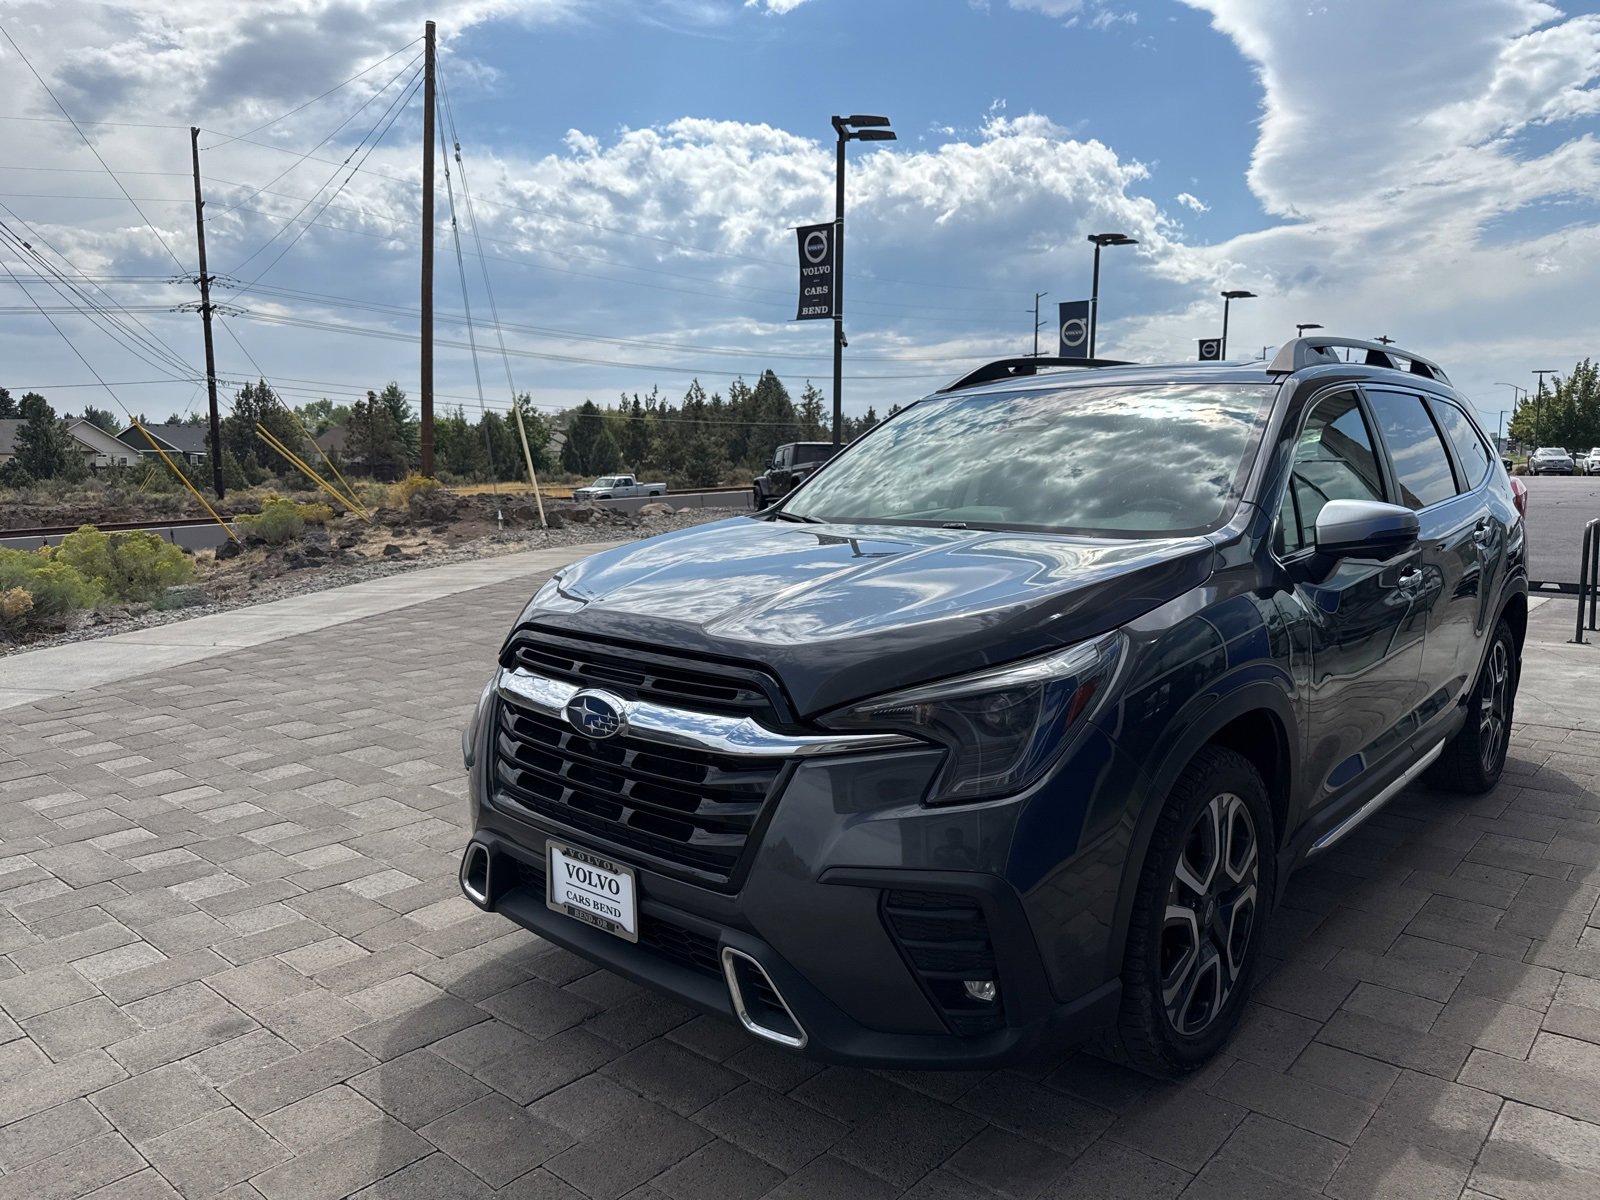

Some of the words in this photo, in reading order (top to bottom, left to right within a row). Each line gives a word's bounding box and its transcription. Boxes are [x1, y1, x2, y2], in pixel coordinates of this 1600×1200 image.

[802, 265, 831, 276] VOLVO
[804, 286, 829, 296] CARS
[801, 305, 829, 315] BEND
[570, 850, 611, 870] VOLVO
[564, 862, 620, 895] VOLVO
[566, 890, 591, 907] CARS
[593, 900, 622, 918] BEND
[597, 918, 608, 928] OR
